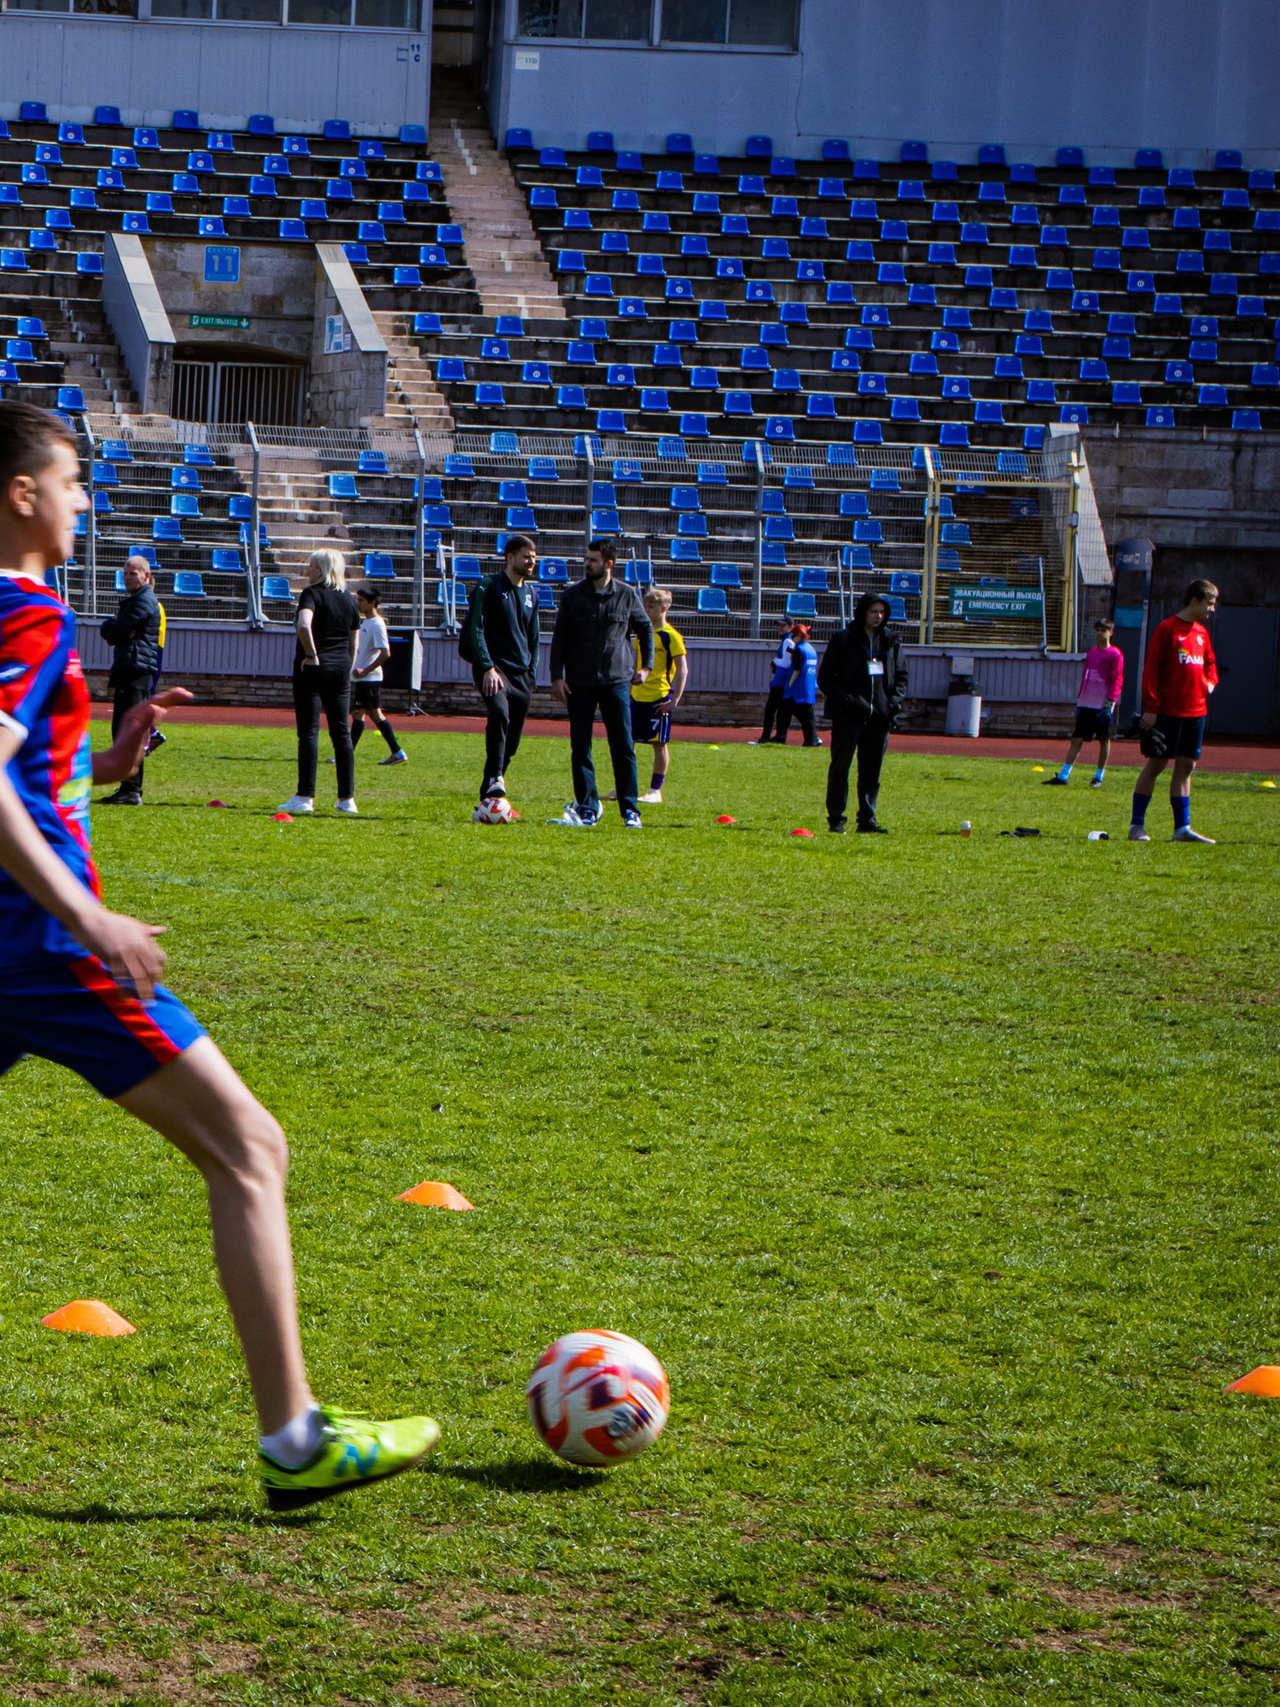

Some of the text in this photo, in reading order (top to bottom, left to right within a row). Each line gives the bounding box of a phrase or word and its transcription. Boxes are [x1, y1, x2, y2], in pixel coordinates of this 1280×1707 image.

[411, 43, 420, 52] 11
[212, 255, 233, 273] 11
[954, 589, 1042, 601] ЭВАКУАЦИОННЫЙ ВЫХОД
[968, 601, 1009, 610] EMERGENCY
[650, 718, 660, 731] 7
